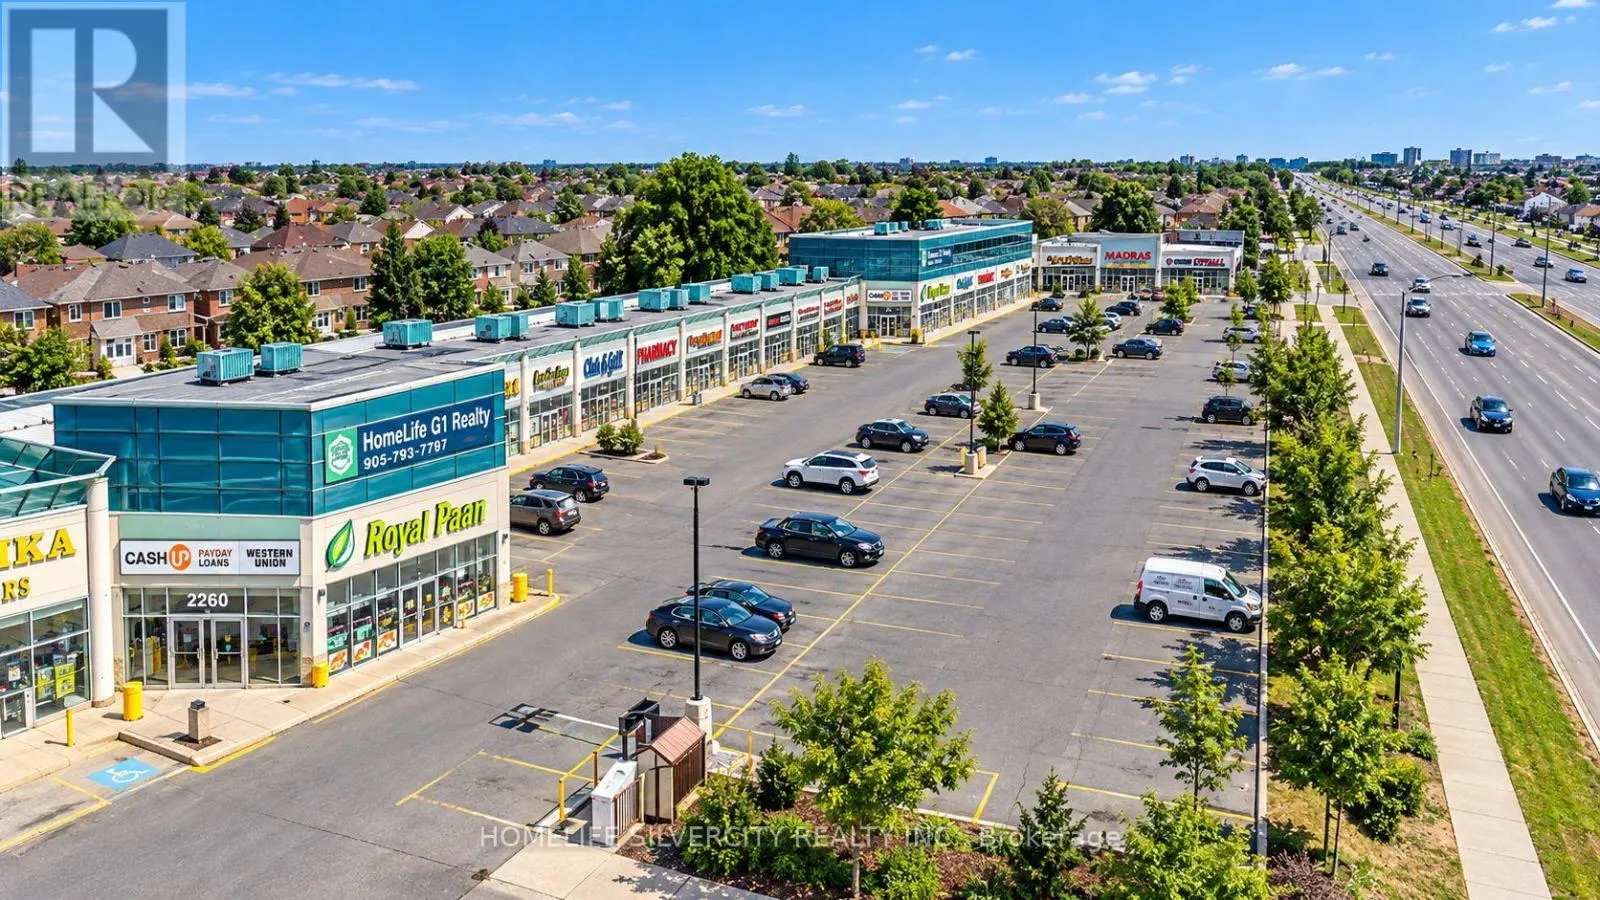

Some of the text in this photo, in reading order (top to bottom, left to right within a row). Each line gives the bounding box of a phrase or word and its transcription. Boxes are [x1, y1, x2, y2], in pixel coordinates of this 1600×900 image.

[1104, 251, 1152, 260] MADRAS
[637, 339, 678, 365] PHARMACY
[363, 419, 427, 452] HomeLife
[431, 415, 447, 435] G1
[452, 407, 491, 431] Realty
[364, 499, 486, 559] Royal Paan
[125, 551, 167, 565] CASH
[198, 548, 232, 558] PAYDAY
[246, 548, 293, 558] WESTERN
[198, 558, 230, 567] LOANS
[254, 558, 286, 568] UNION
[187, 593, 228, 607] 2260
